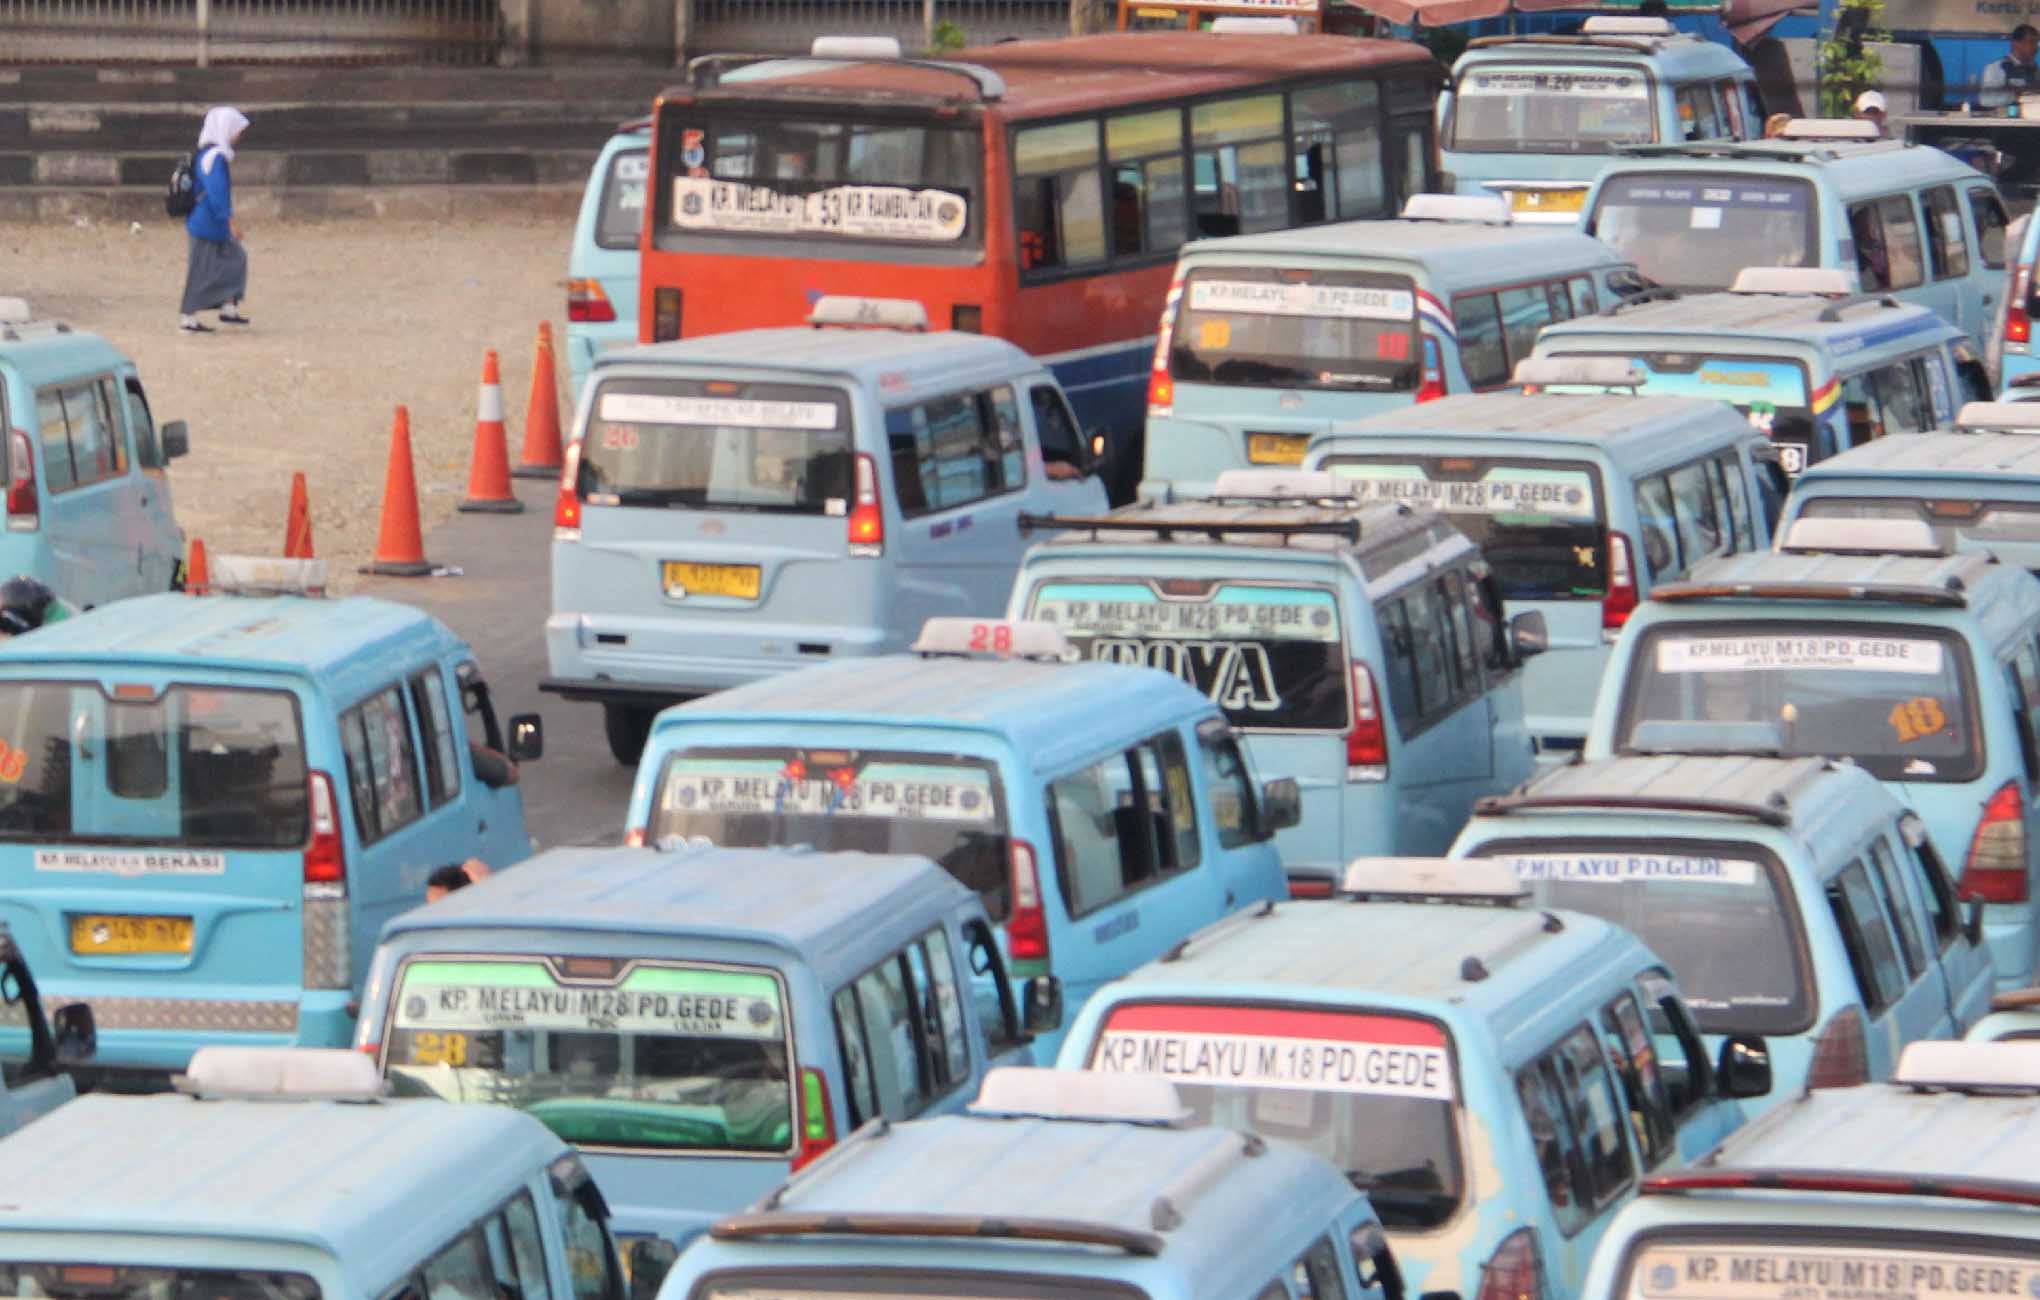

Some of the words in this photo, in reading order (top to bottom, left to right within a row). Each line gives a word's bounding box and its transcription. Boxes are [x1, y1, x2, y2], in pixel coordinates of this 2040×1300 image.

[820, 189, 842, 226] 53
[1379, 483, 1442, 500] MELAYU
[1450, 485, 1483, 506] M28
[1098, 602, 1170, 623] MELAYU
[1177, 604, 1217, 630] M28
[969, 624, 1013, 654] 28
[1776, 640, 1819, 658] M18
[1887, 696, 1947, 745] 18
[145, 856, 220, 869] BEKASI
[479, 989, 568, 1014] MELAYU
[580, 991, 627, 1016] M28
[413, 1031, 466, 1066] 28
[1729, 1259, 1831, 1286] MELAYU
[1841, 1261, 1900, 1290] M18
